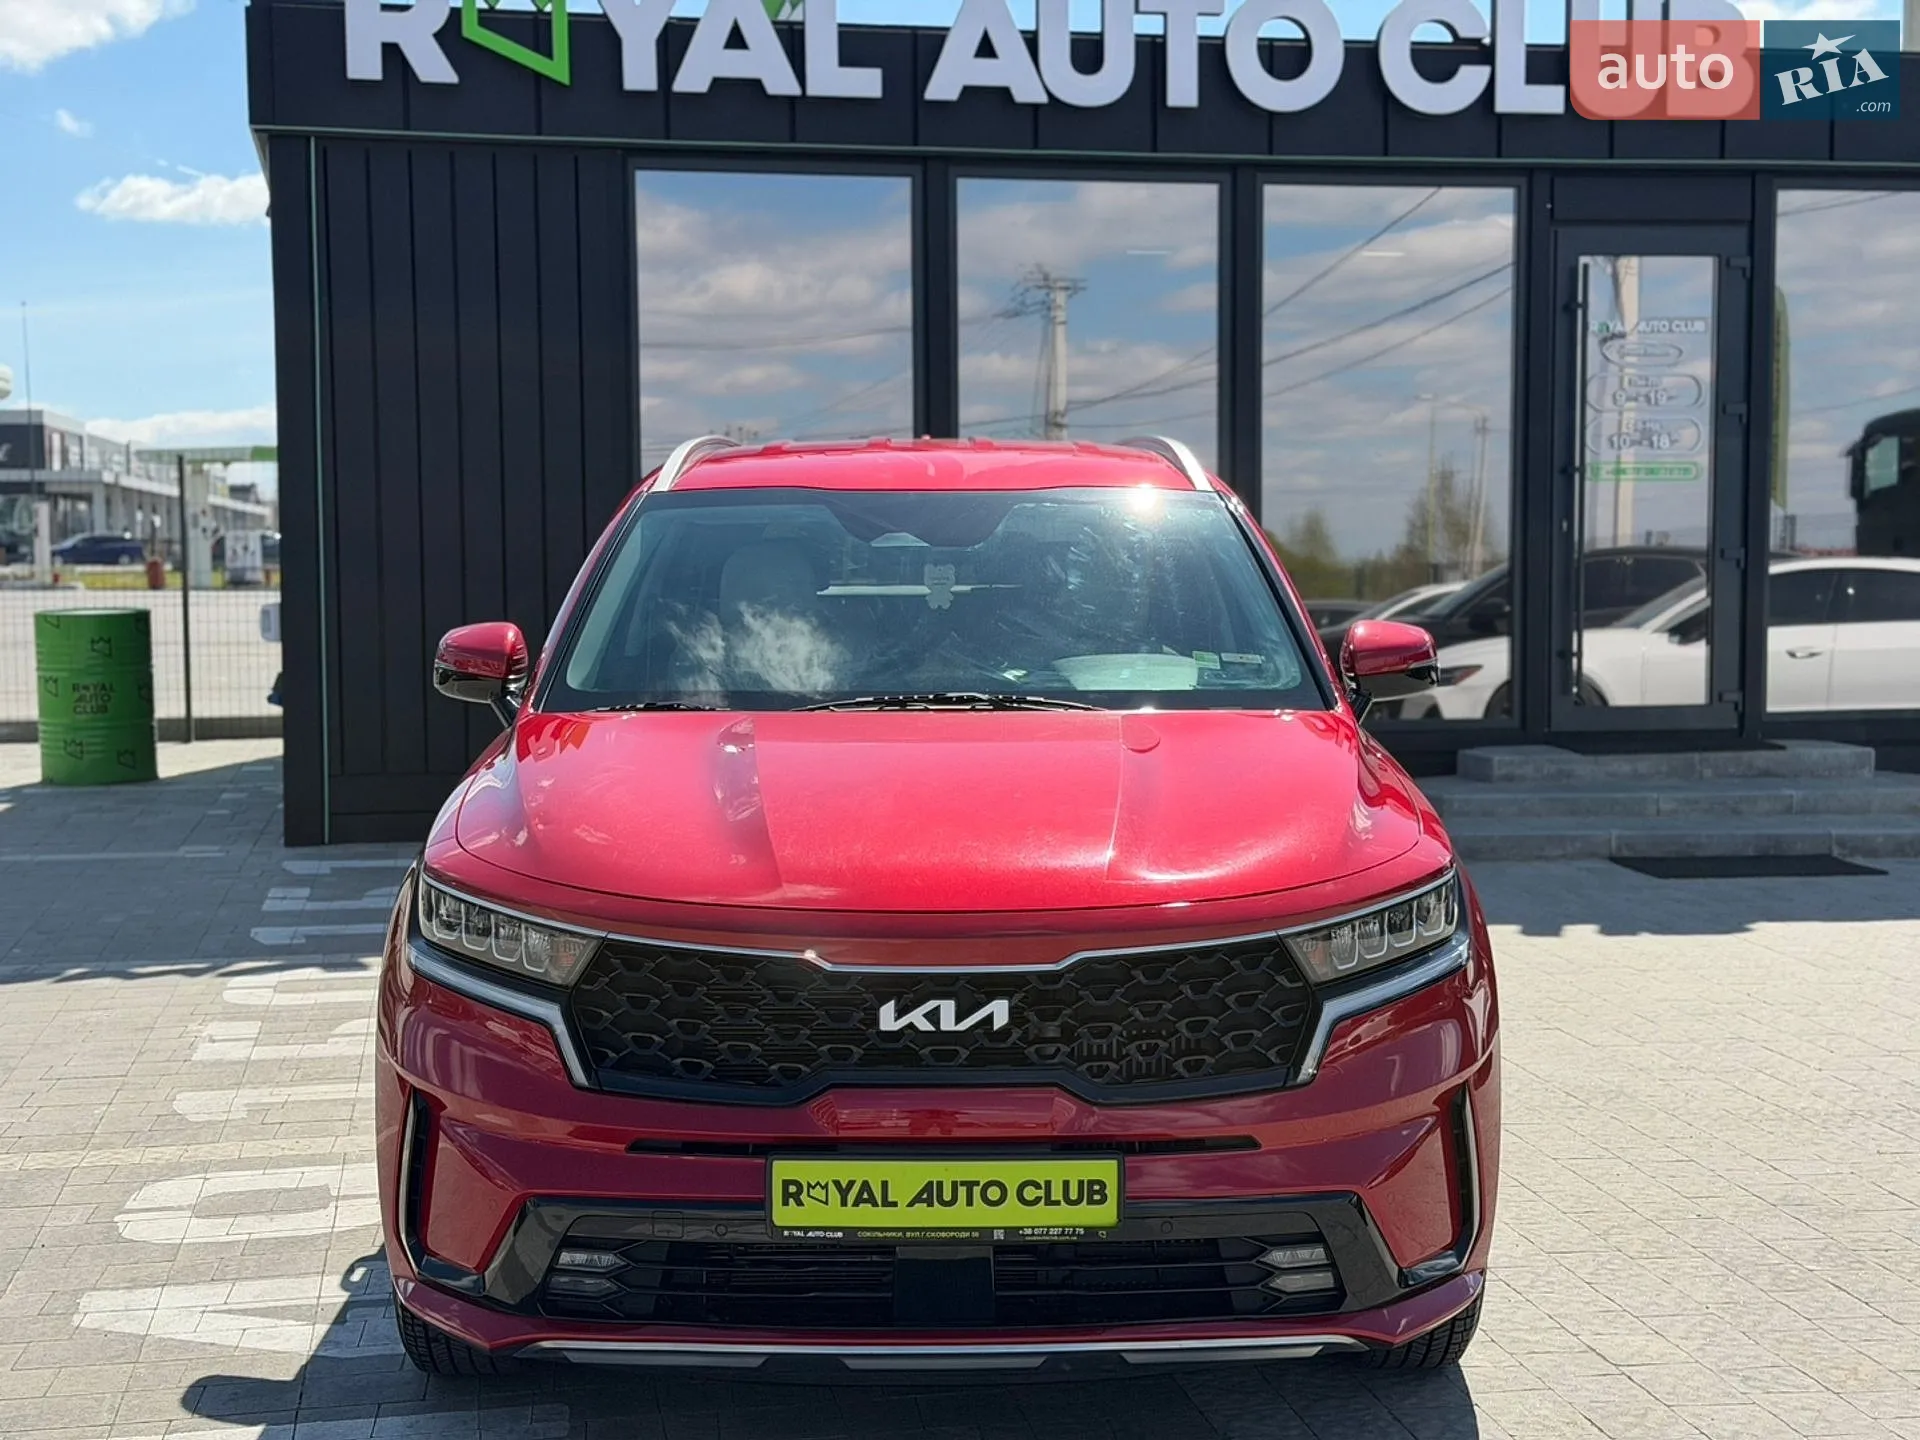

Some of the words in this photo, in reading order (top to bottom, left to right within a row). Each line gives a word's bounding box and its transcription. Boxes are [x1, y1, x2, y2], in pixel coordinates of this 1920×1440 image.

[923, 0, 1345, 113] AUTO
[1378, 0, 1754, 117] CLUB
[1672, 319, 1706, 333] CLUB
[904, 1178, 1008, 1208] AUTO
[1015, 1177, 1108, 1208] CLUB
